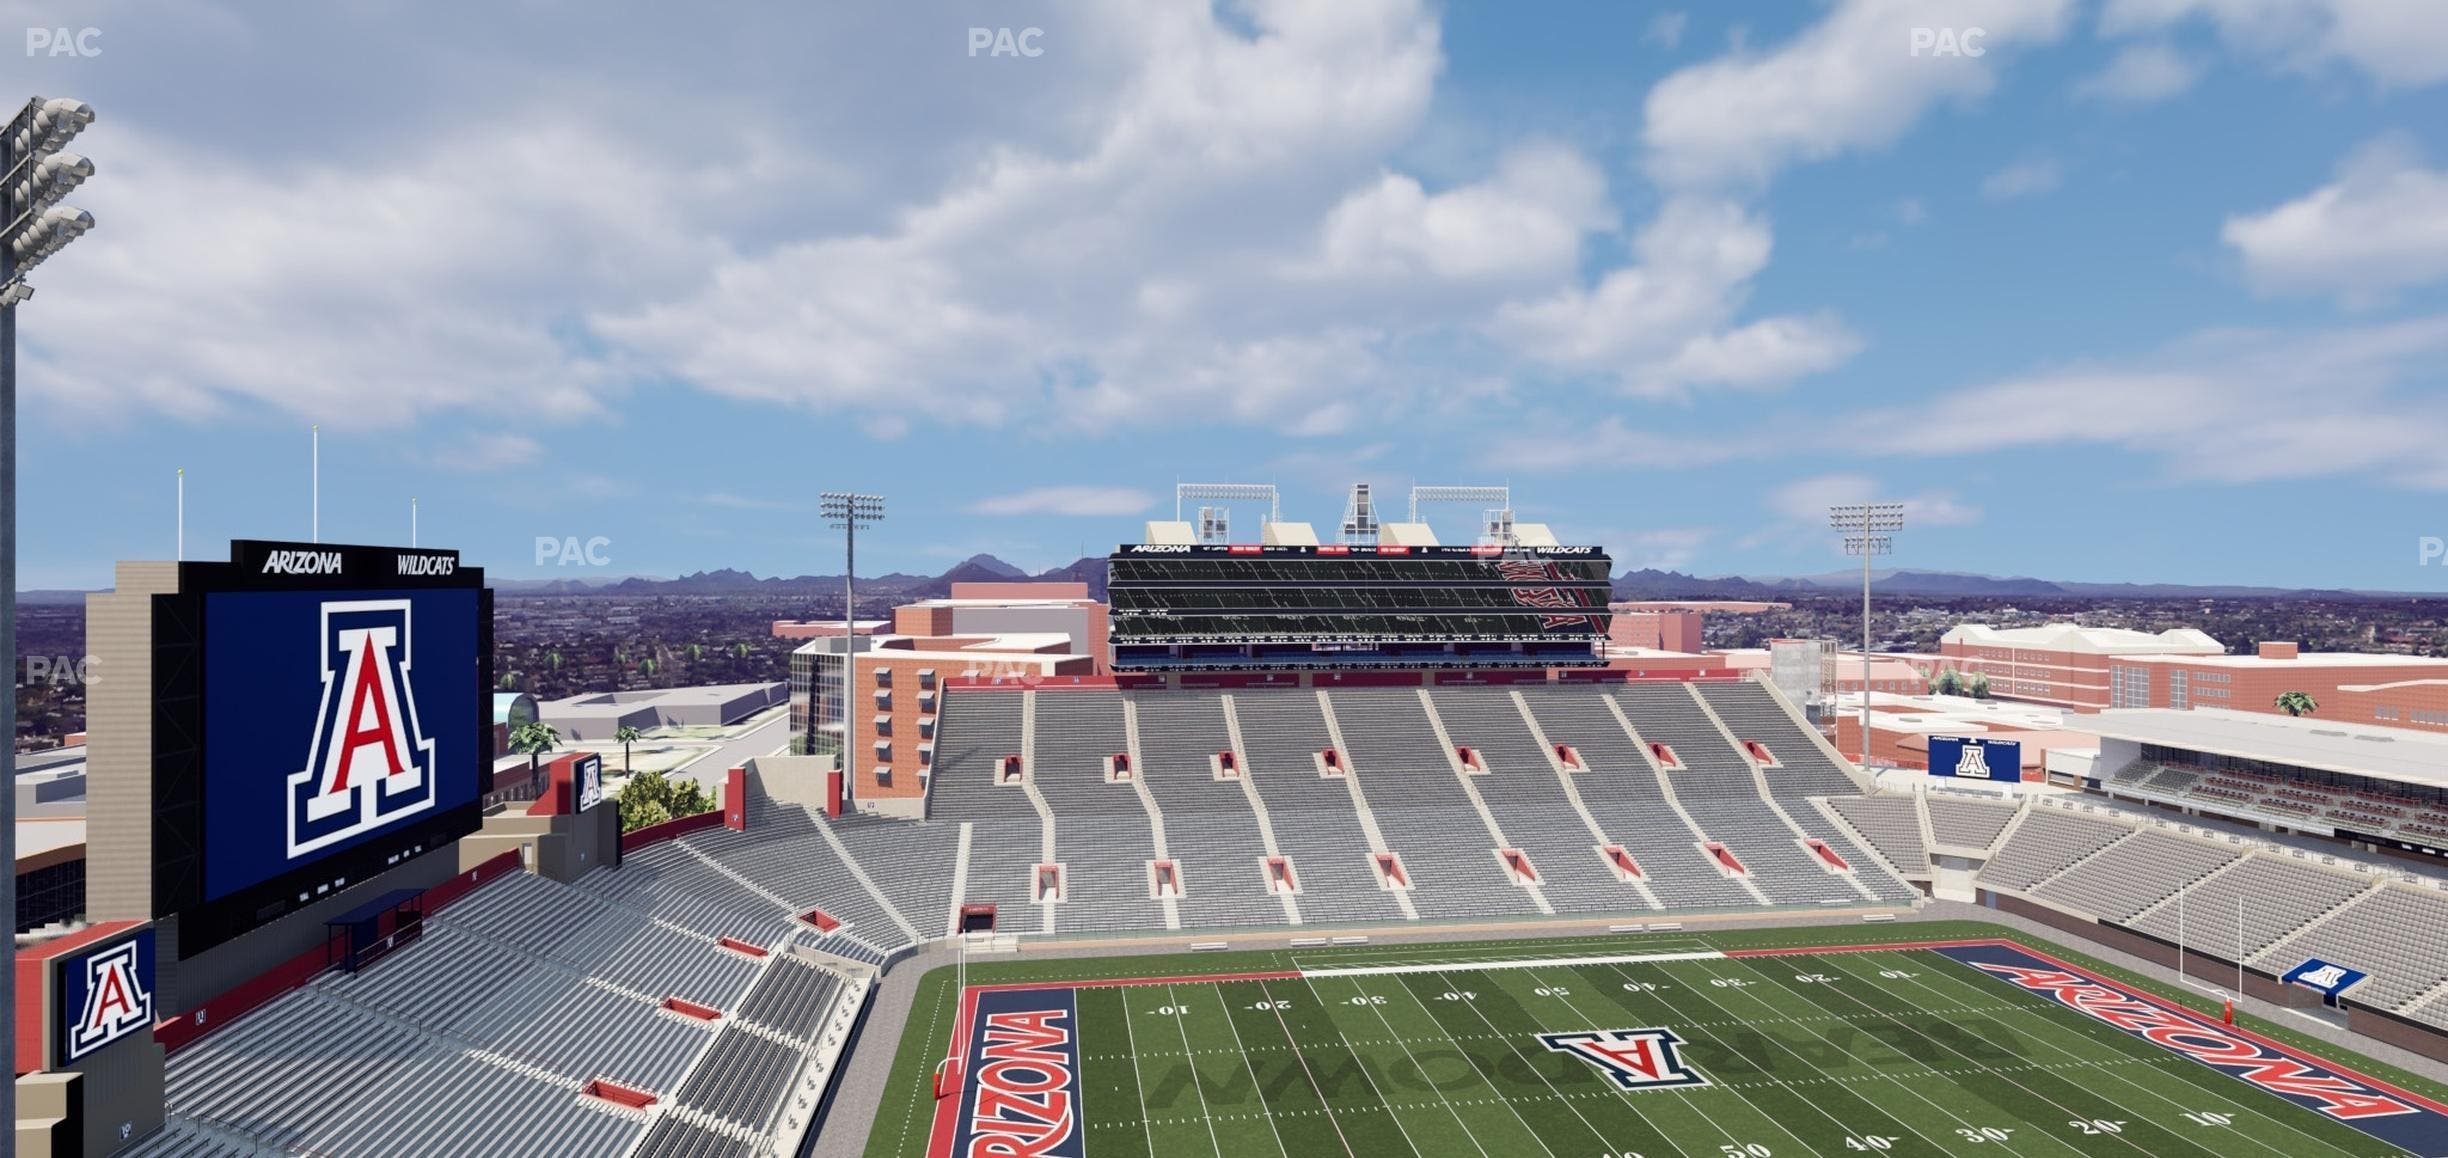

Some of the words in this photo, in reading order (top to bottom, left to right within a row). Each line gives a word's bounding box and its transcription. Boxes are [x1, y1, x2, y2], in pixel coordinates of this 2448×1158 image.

[1130, 545, 1191, 553] ARIZONA
[1535, 546, 1593, 554] WILDCATS
[262, 550, 342, 574] ARIZONA
[397, 554, 455, 575] WILDCATS
[286, 599, 436, 860] A
[1955, 744, 1990, 778] A
[580, 759, 601, 812] A
[1710, 977, 1747, 988] 30
[1795, 973, 1832, 984] 20
[1878, 970, 1913, 979] 10
[1533, 986, 1571, 997] 50
[1623, 981, 1657, 993] 40
[70, 939, 151, 1060] A
[1351, 995, 1388, 1006] 30
[1441, 990, 1479, 1002] 40
[1158, 1004, 1192, 1016] 10
[1255, 1000, 1292, 1011] 20
[1967, 961, 2421, 1120] ARIZONA
[1536, 1026, 1712, 1091] A
[967, 1009, 1074, 1158] RIZONA
[2068, 1118, 2122, 1135] 20
[2179, 1111, 2231, 1126] 10
[1845, 1134, 1893, 1151] 40
[1955, 1126, 2009, 1143] 30
[1719, 1142, 1772, 1158] 50
